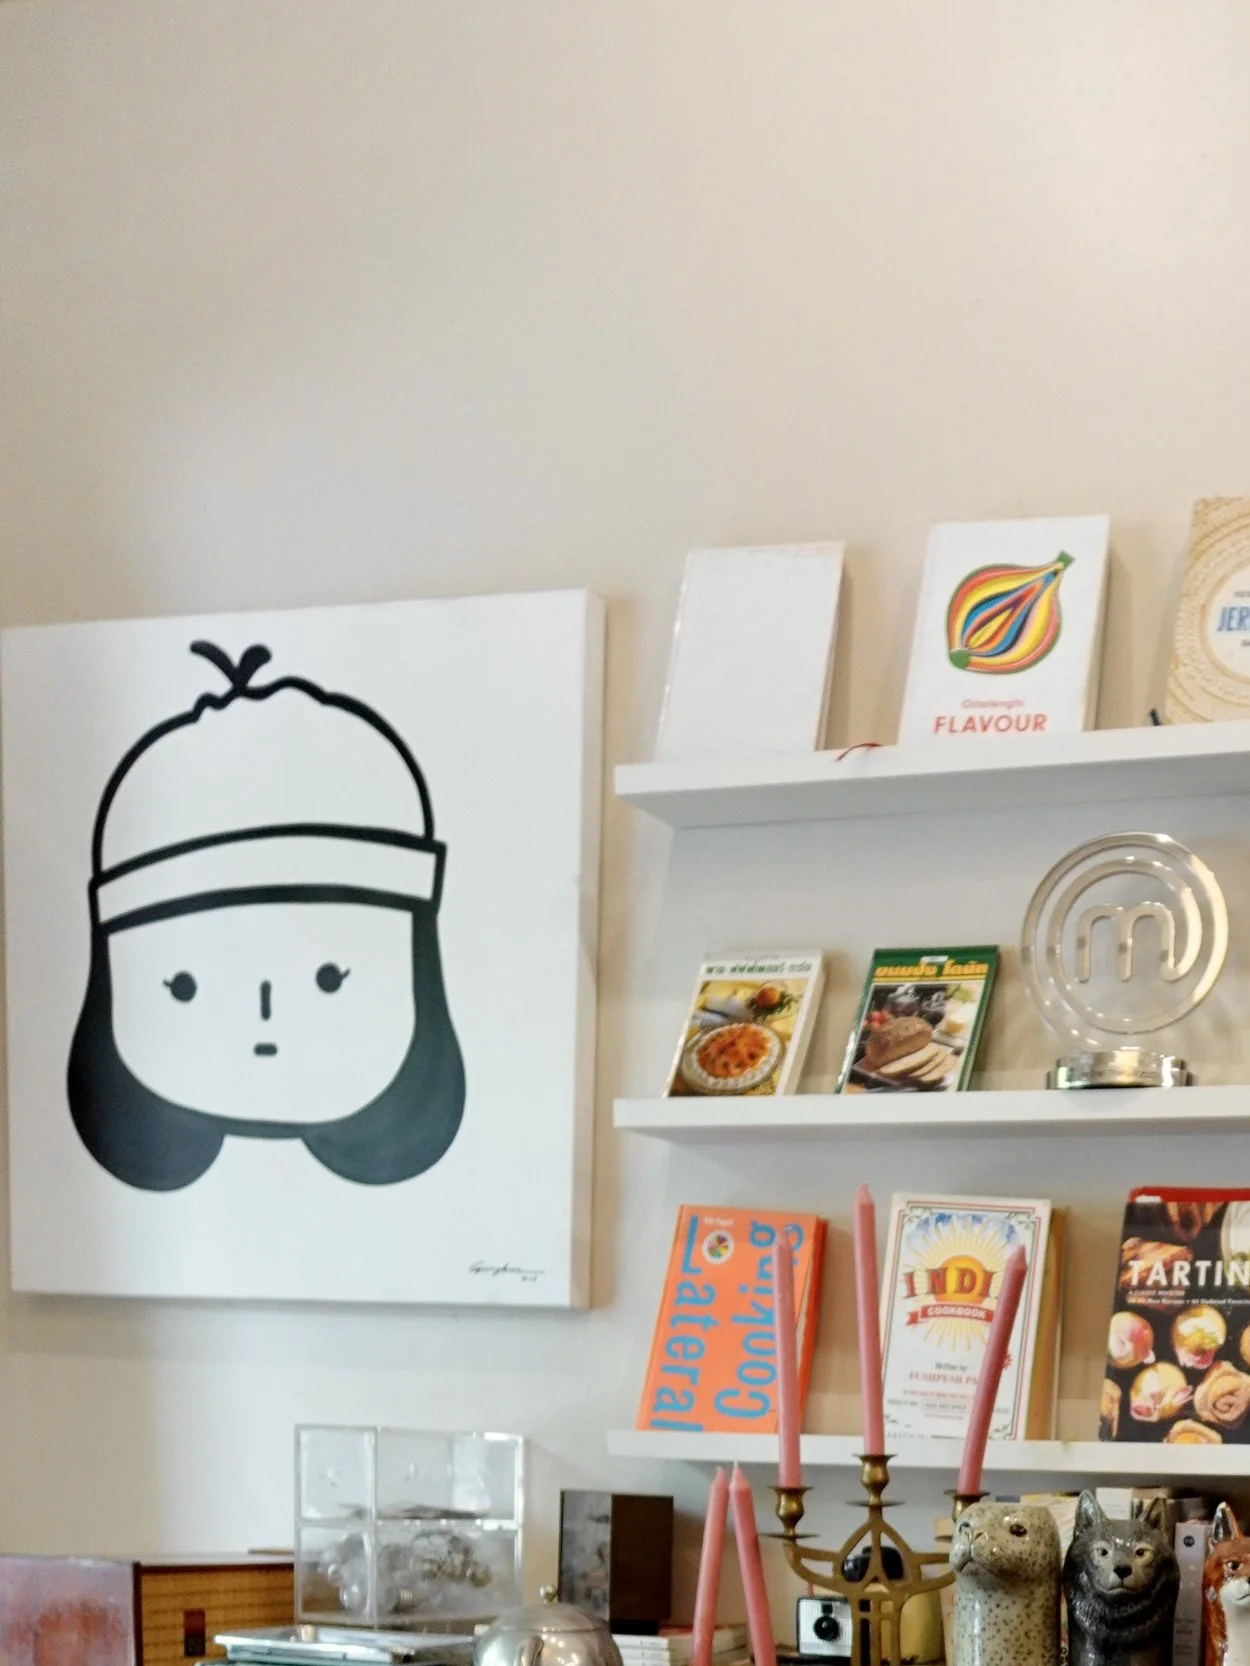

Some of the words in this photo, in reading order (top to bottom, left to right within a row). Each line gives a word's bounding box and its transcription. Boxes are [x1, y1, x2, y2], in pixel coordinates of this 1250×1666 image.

[934, 713, 1047, 734] FLAVOUR
[903, 1267, 1001, 1299] INDI
[650, 1215, 722, 1432] Lateral
[928, 1305, 985, 1318] COOKBOOK
